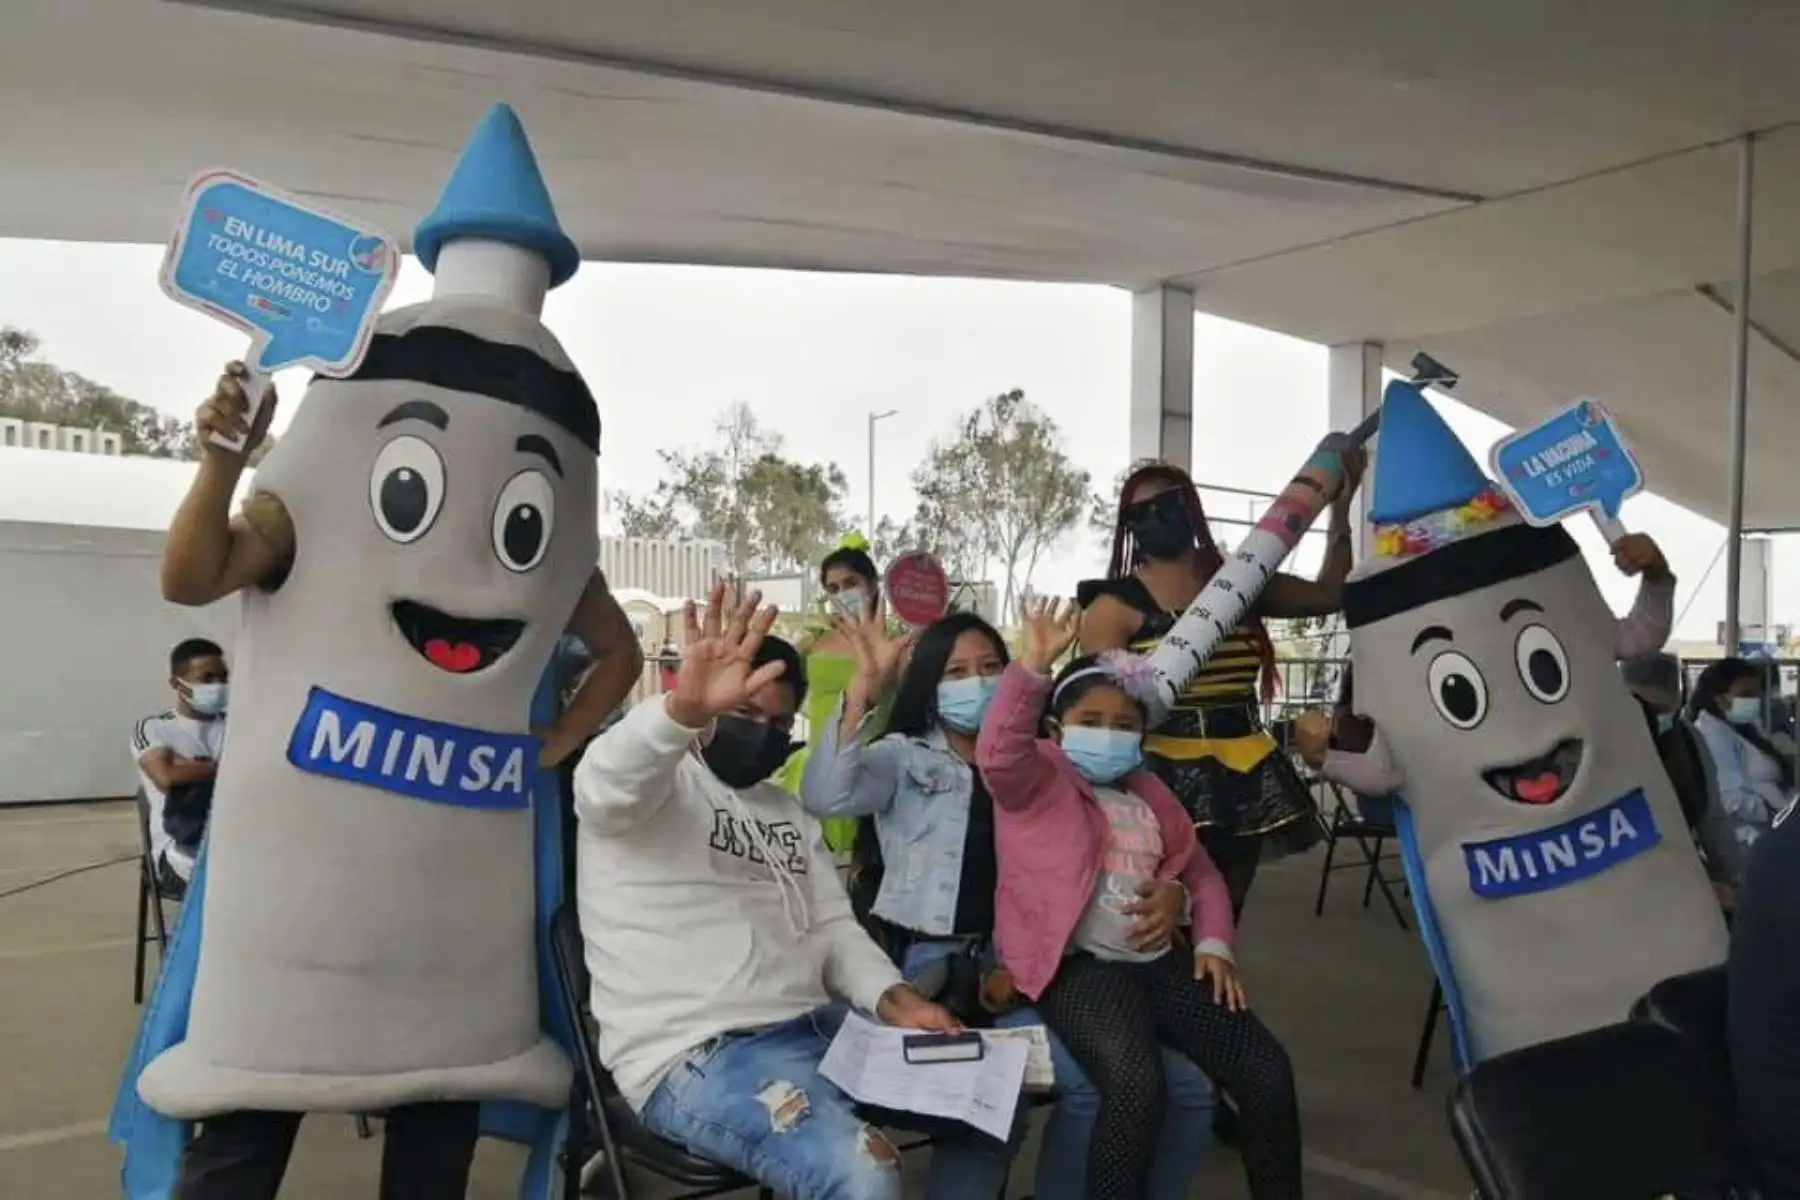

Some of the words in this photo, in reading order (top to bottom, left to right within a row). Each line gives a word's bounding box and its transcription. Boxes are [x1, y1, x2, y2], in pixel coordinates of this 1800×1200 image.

[208, 233, 269, 267] TODOS
[267, 259, 356, 300] PONEMOS
[223, 216, 253, 241] EN
[256, 230, 305, 261] LIMA
[309, 251, 349, 279] SUR
[216, 260, 239, 279] EL
[243, 268, 331, 313] HOMBRO
[1522, 455, 1546, 477] LA
[1544, 470, 1563, 488] ES
[1563, 454, 1596, 478] VIDA
[310, 709, 525, 793] MINSA
[1474, 808, 1638, 886] MINSA
